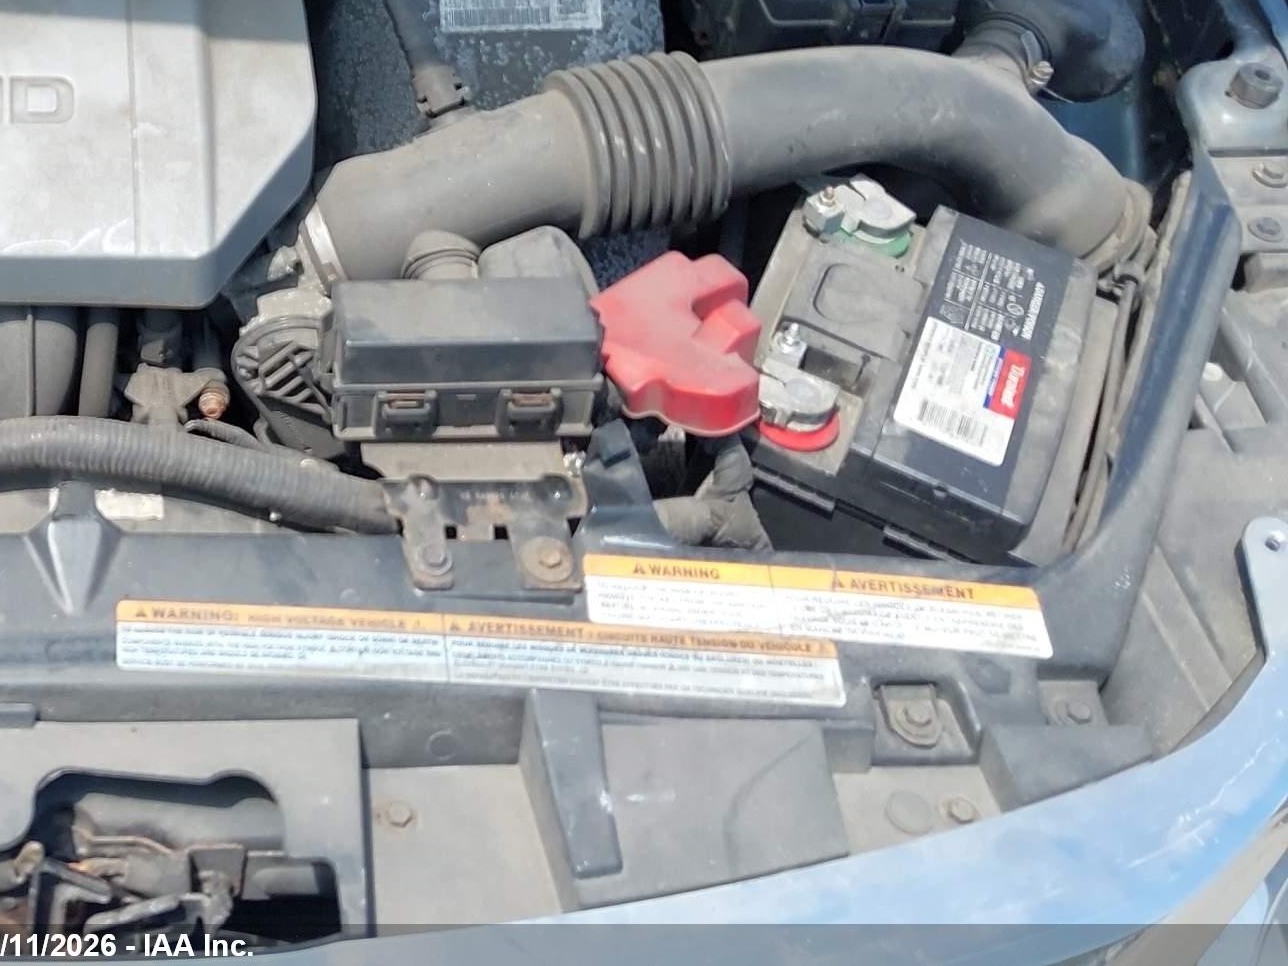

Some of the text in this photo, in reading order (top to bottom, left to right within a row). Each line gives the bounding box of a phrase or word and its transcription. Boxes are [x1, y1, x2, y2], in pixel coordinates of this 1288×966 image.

[648, 563, 721, 580] WARNING
[849, 577, 976, 600] AVERTISSEMENT
[287, 615, 345, 627] VOLTAGE
[350, 617, 406, 630] VEHICLE
[467, 621, 583, 638] AVERTISSEMENT
[651, 633, 686, 646] HAUTE
[690, 635, 737, 648] TENSION
